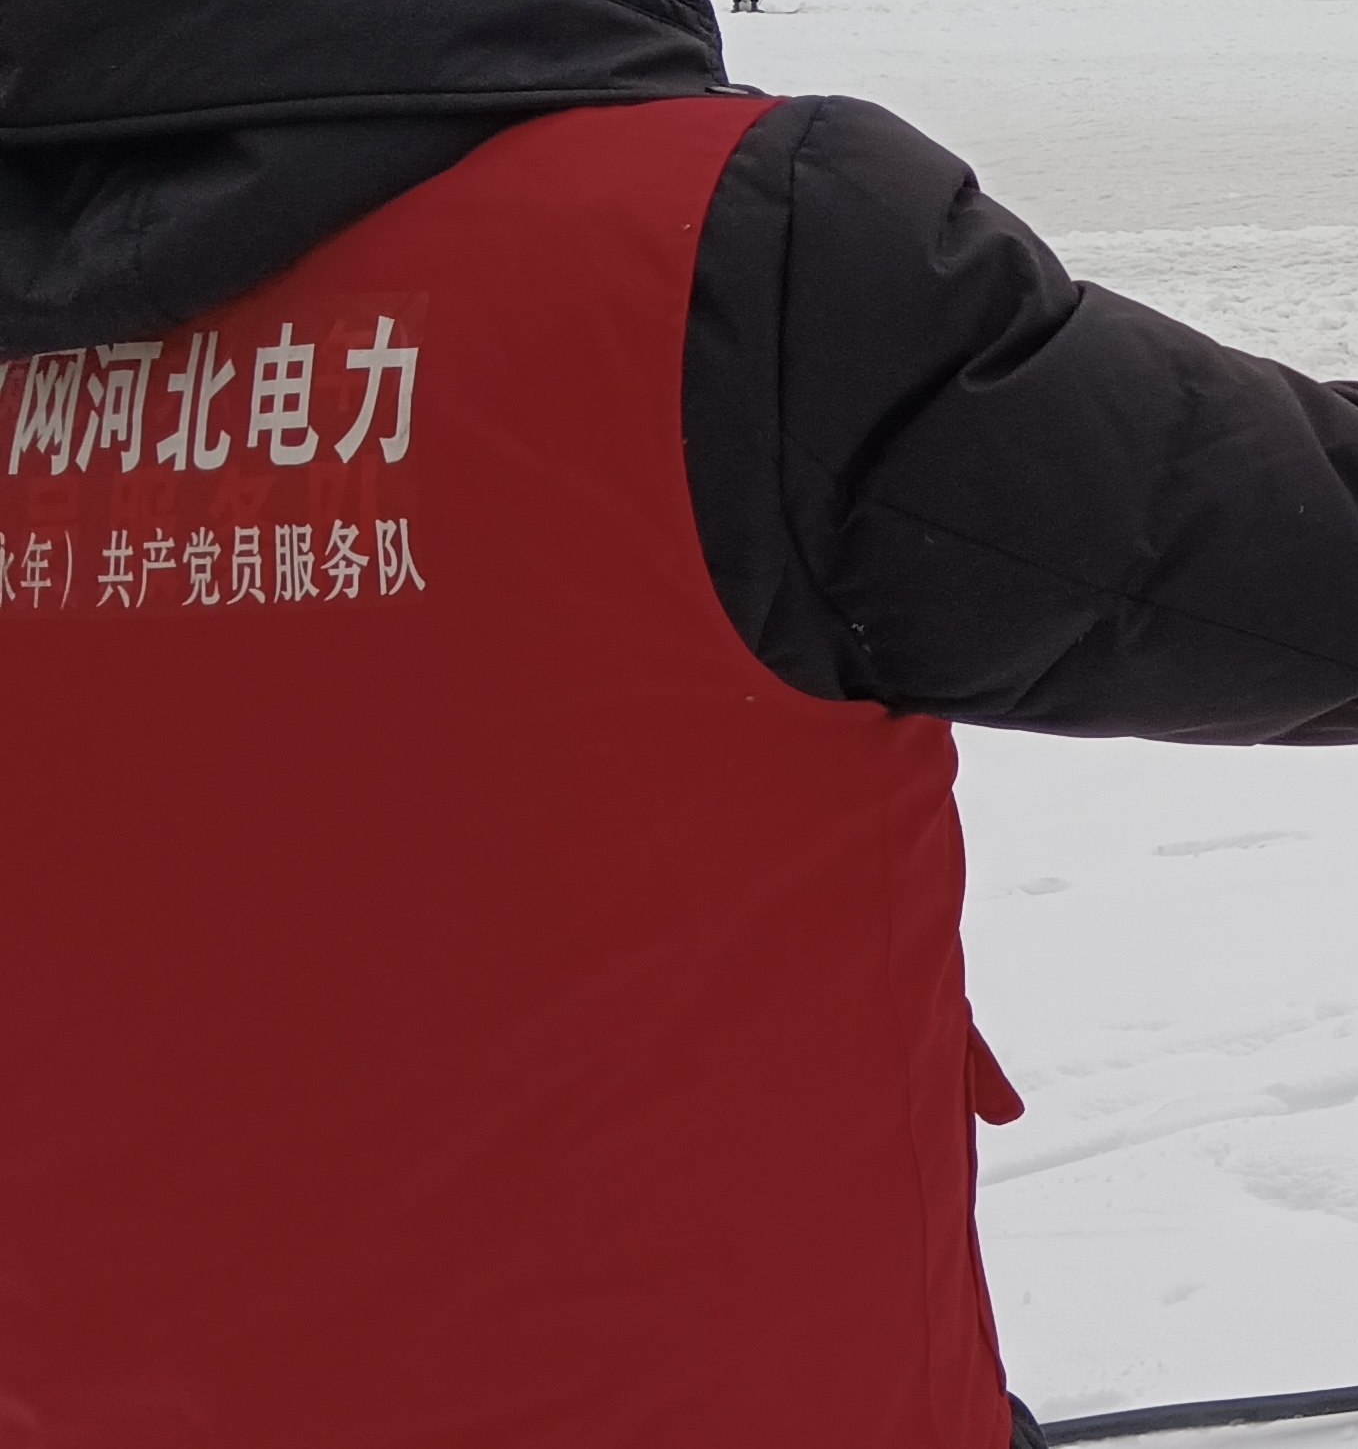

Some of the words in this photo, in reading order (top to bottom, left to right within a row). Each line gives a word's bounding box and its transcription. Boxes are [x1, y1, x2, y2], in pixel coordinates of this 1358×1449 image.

[0, 316, 418, 476] 网河北电力
